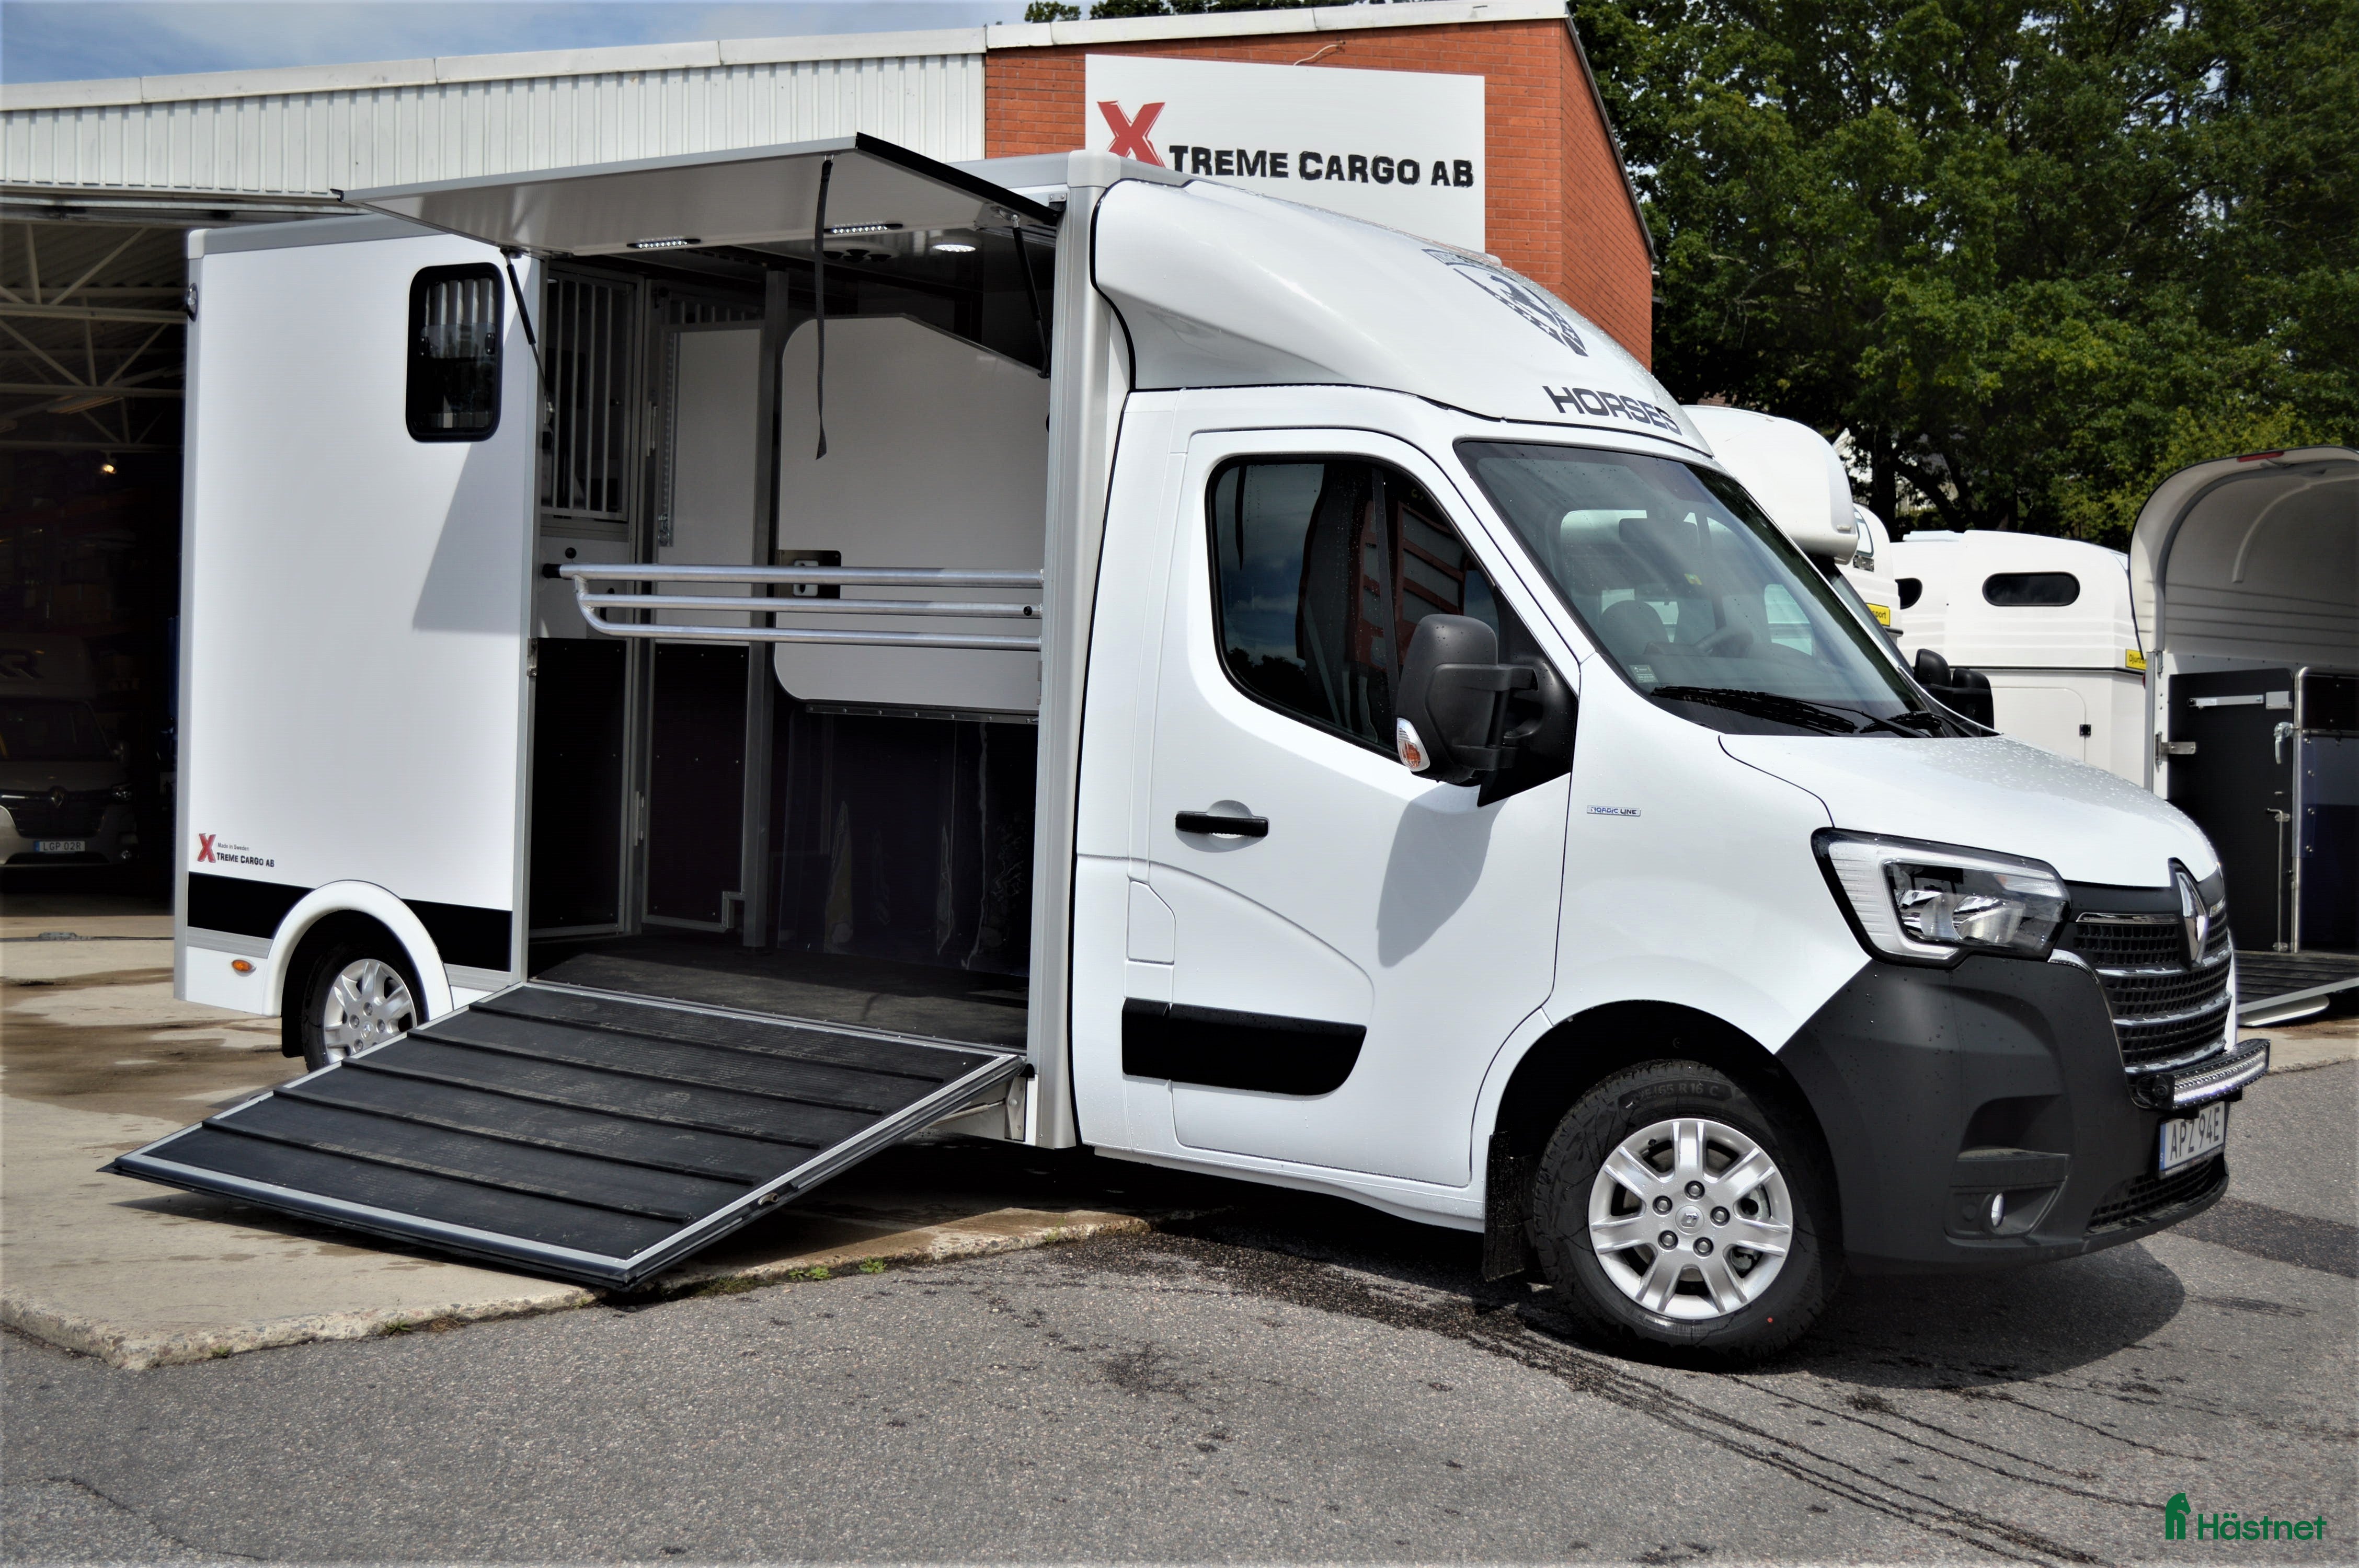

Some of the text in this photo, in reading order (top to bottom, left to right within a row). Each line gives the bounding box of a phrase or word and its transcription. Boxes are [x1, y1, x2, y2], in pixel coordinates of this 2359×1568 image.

[1298, 151, 1421, 185] CARGO
[1430, 159, 1475, 188] AB
[1542, 385, 1682, 436] HORSES
[43, 842, 61, 851] LGP
[241, 855, 264, 866] CARGO
[266, 859, 275, 868] AB
[2170, 1118, 2195, 1160] APZ
[2199, 1106, 2220, 1149] 94E
[2160, 1152, 2163, 1162] S
